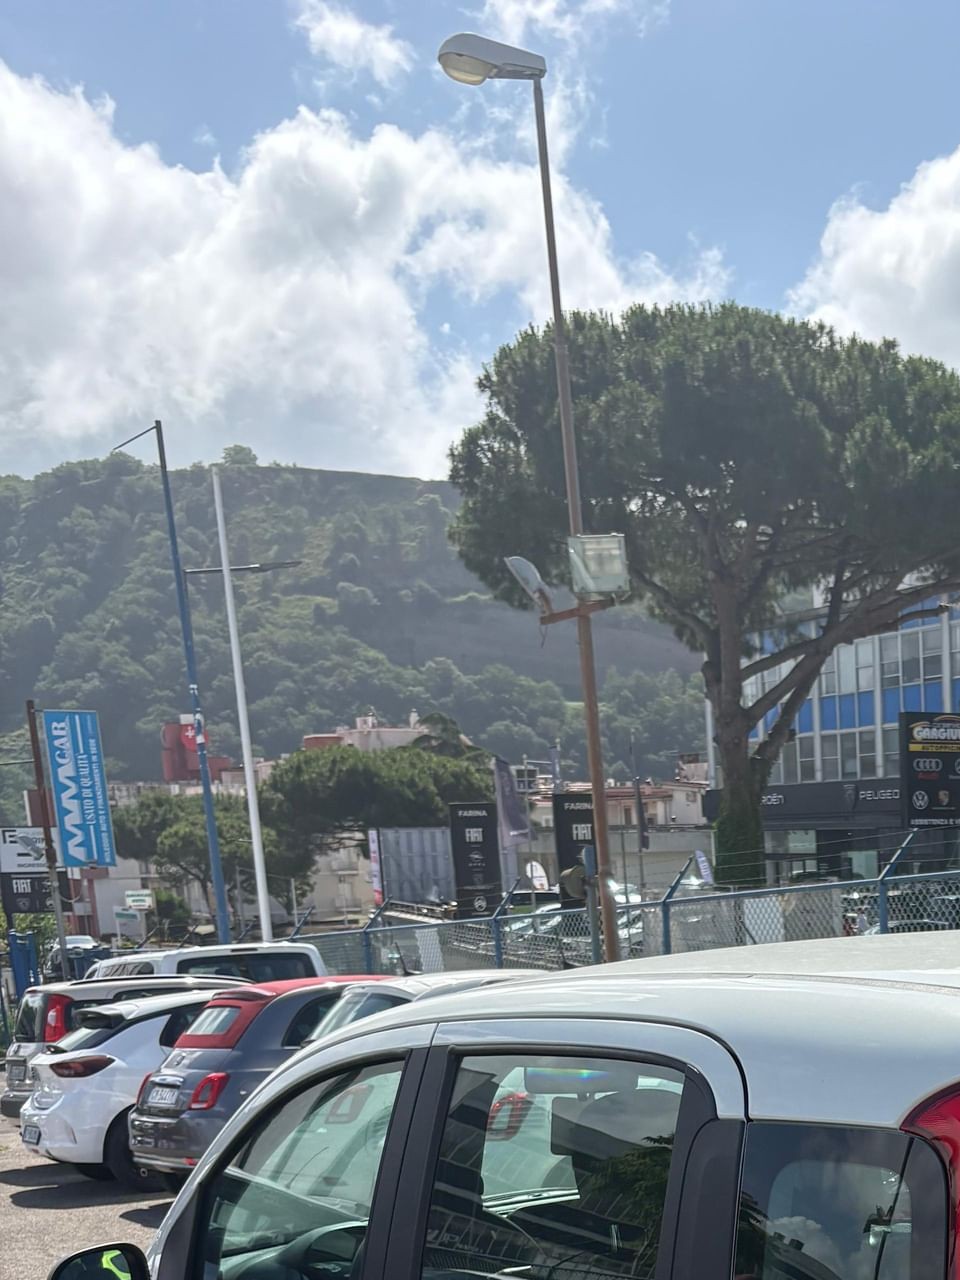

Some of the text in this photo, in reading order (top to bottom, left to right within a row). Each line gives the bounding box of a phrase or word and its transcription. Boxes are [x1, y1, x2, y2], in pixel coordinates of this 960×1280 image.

[82, 790, 93, 799] DI
[859, 789, 900, 800] PEUGEO
[85, 800, 97, 825] USATO
[465, 828, 483, 842] FIAT
[572, 824, 592, 840] FIAT
[12, 880, 32, 893] FIAT
